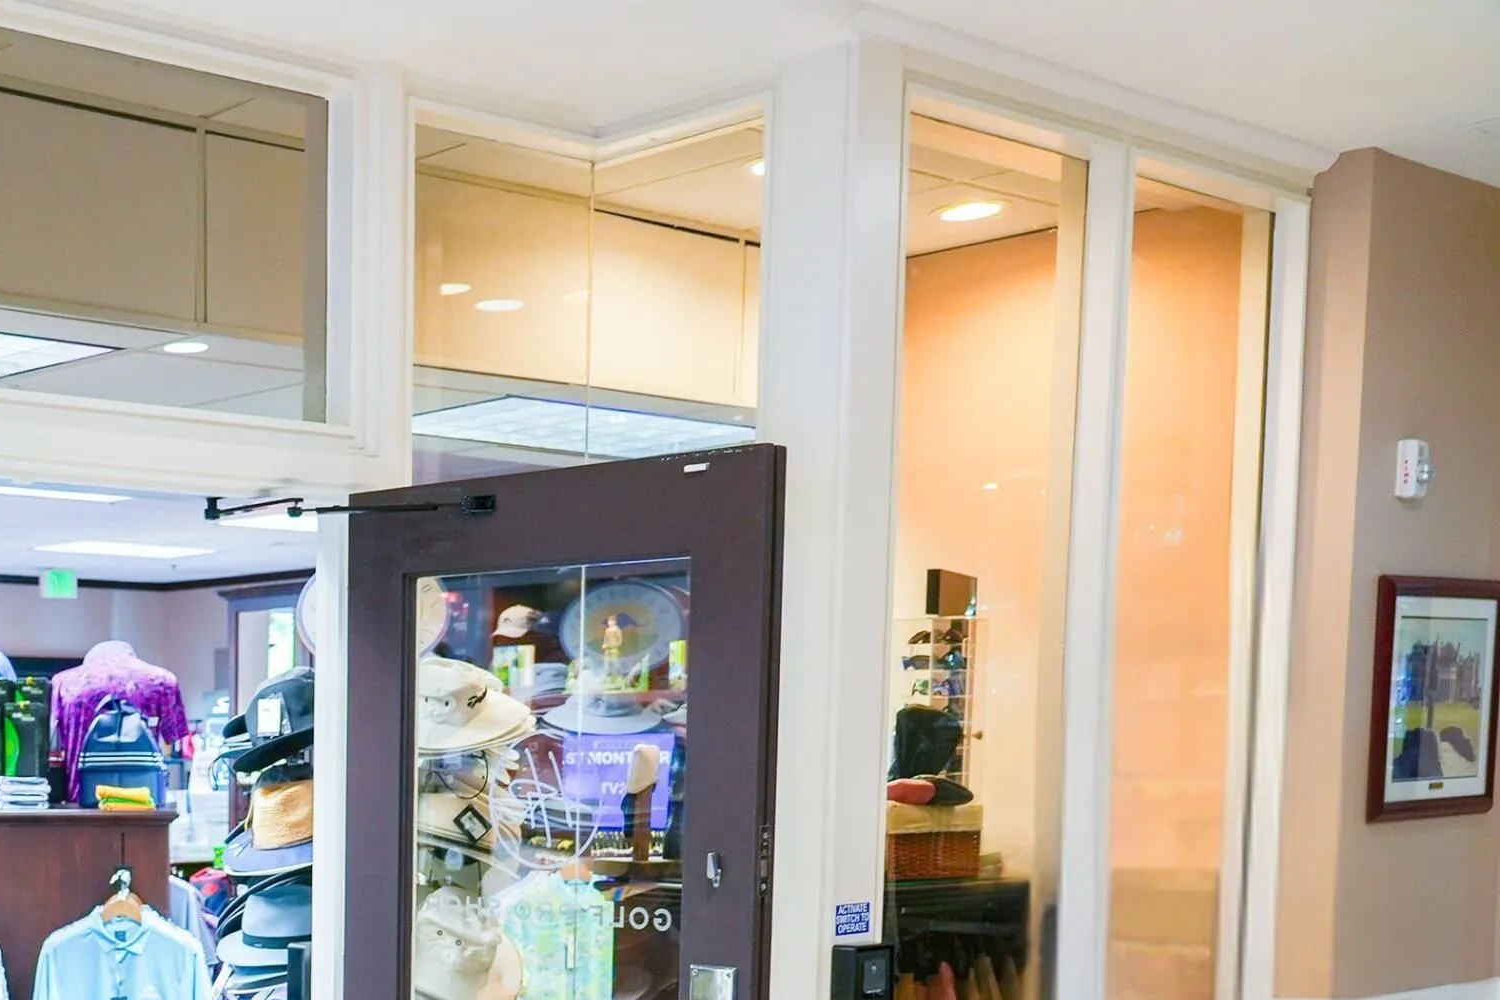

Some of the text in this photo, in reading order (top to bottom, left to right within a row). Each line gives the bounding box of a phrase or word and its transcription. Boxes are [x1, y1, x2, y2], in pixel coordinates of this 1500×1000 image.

[838, 903, 867, 914] ACTIVATE
[836, 912, 869, 924] SWITCH TO
[838, 922, 866, 934] OPERATE
